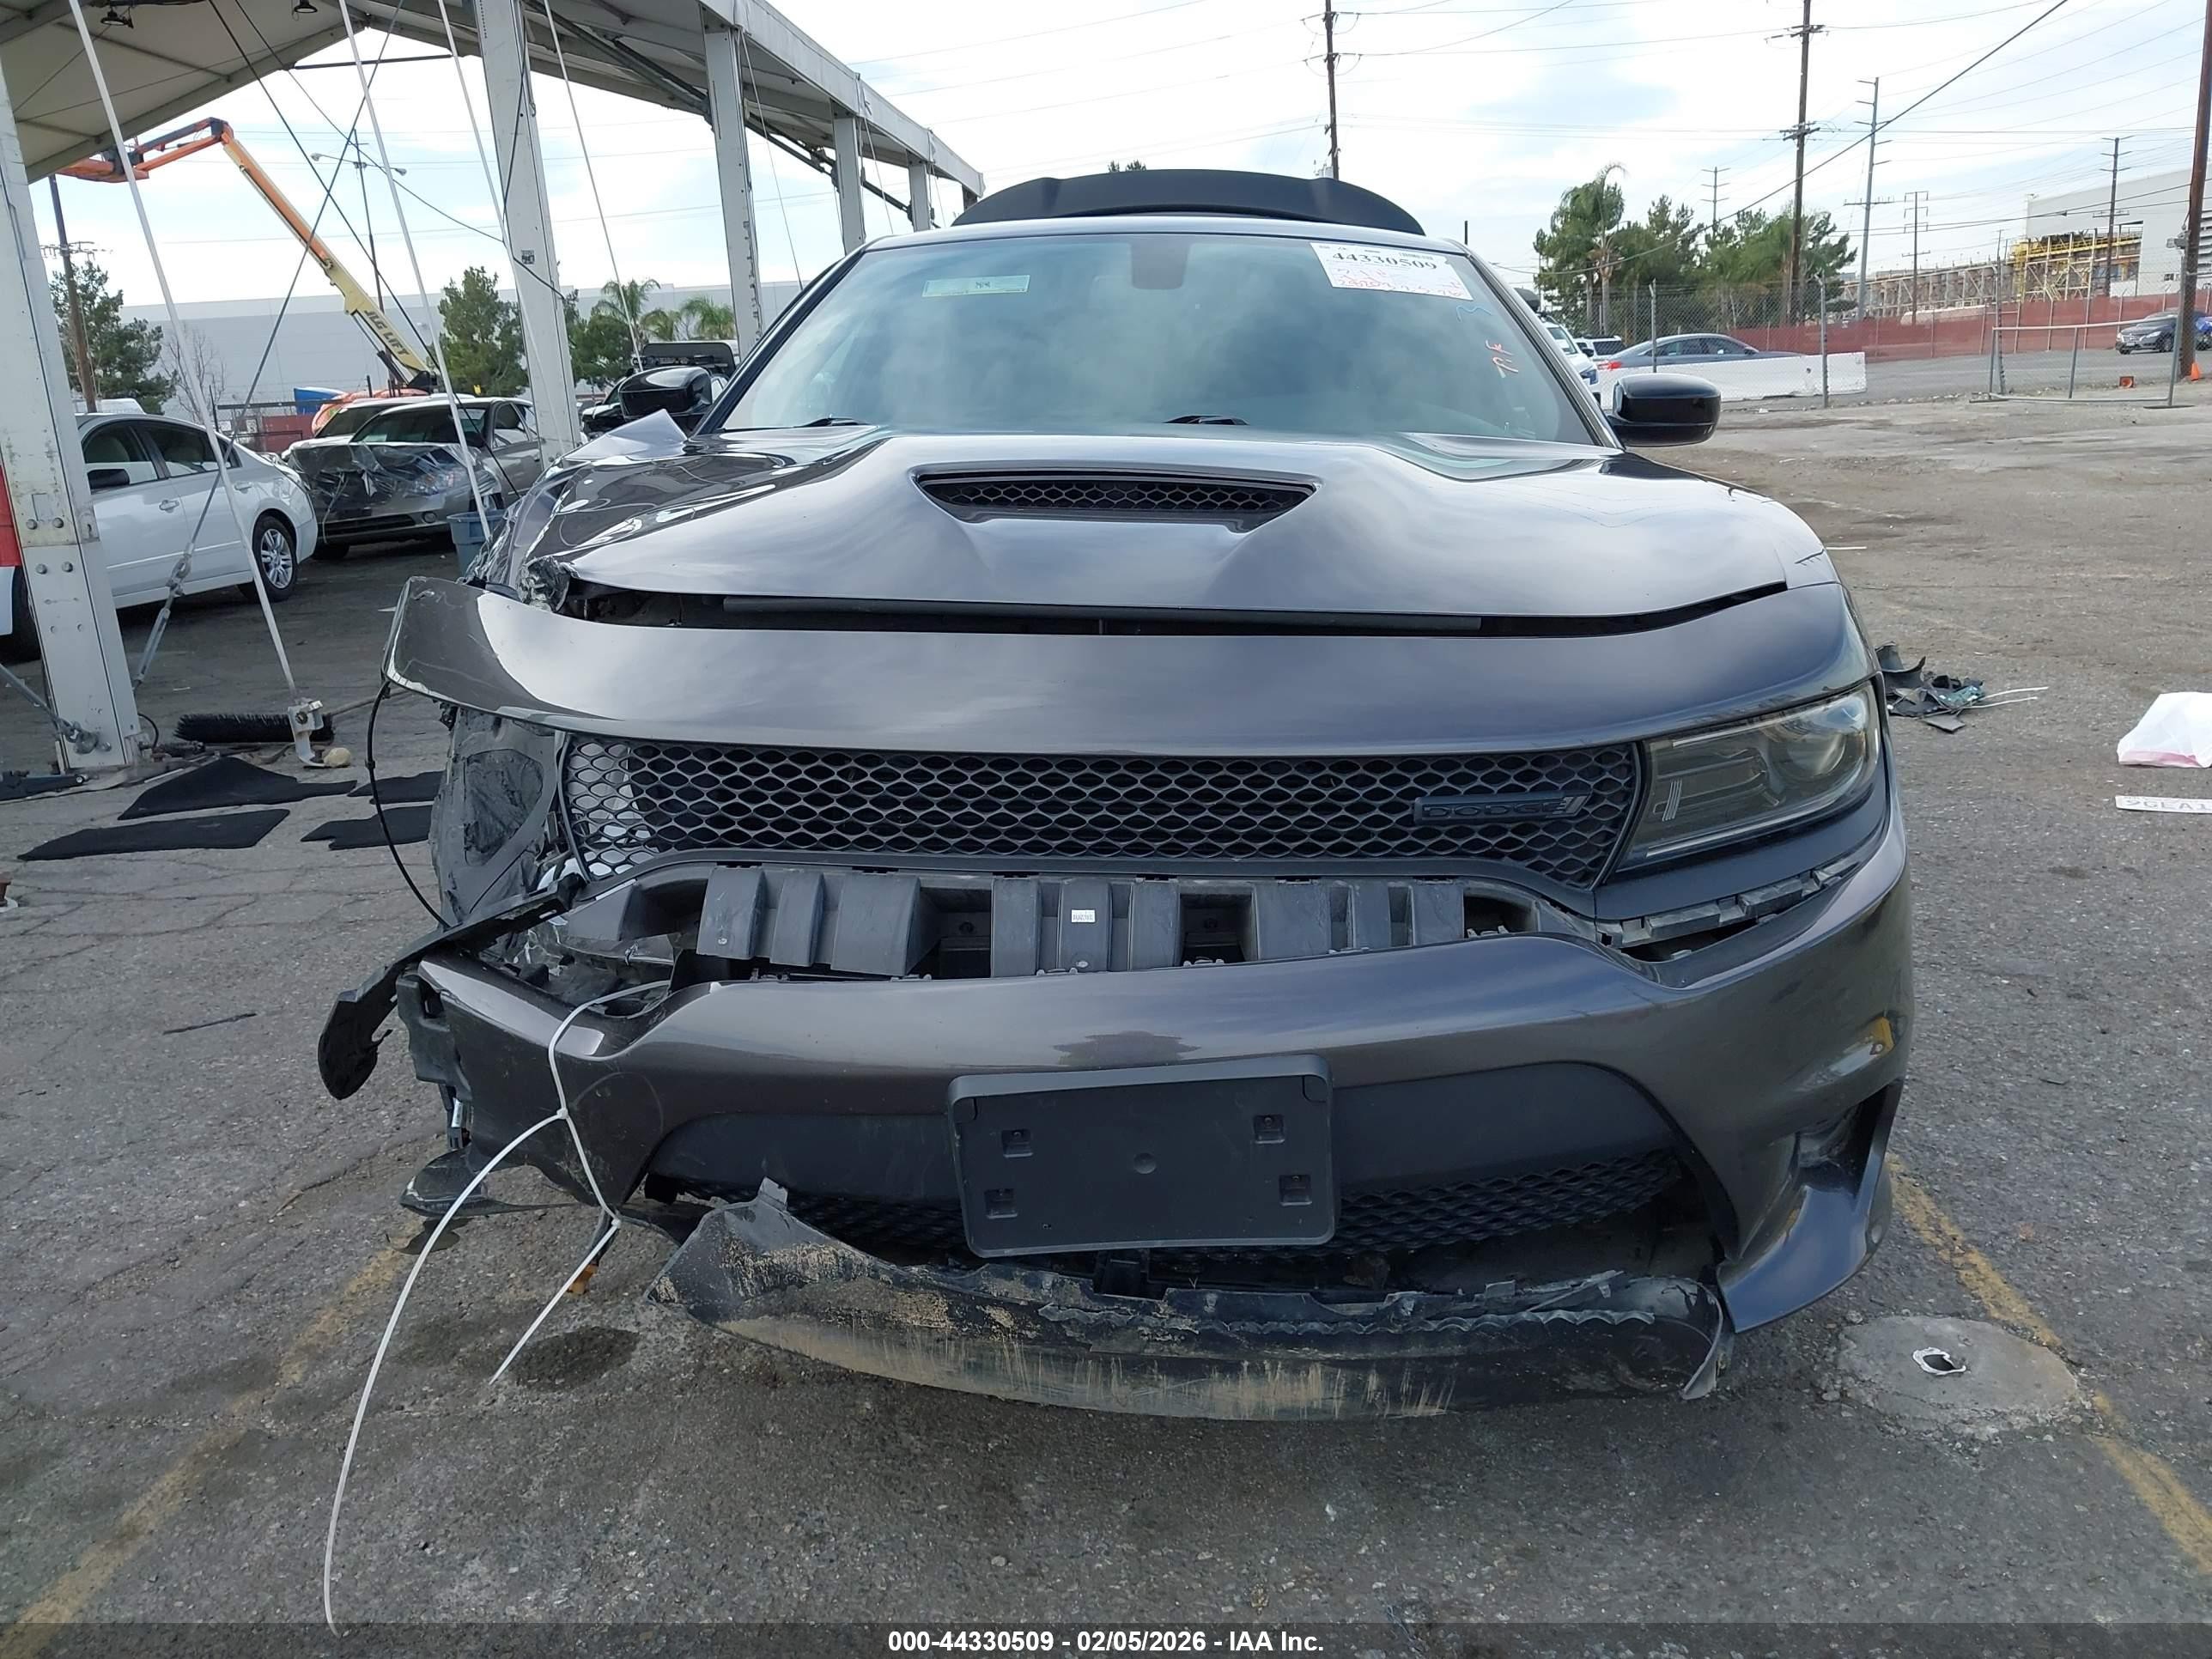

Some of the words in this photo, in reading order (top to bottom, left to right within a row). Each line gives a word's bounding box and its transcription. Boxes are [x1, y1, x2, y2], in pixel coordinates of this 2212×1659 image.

[1333, 252, 1437, 270] 44330509
[363, 310, 388, 331] JLG
[382, 331, 410, 356] LIFT
[1423, 800, 1567, 817] DODGE
